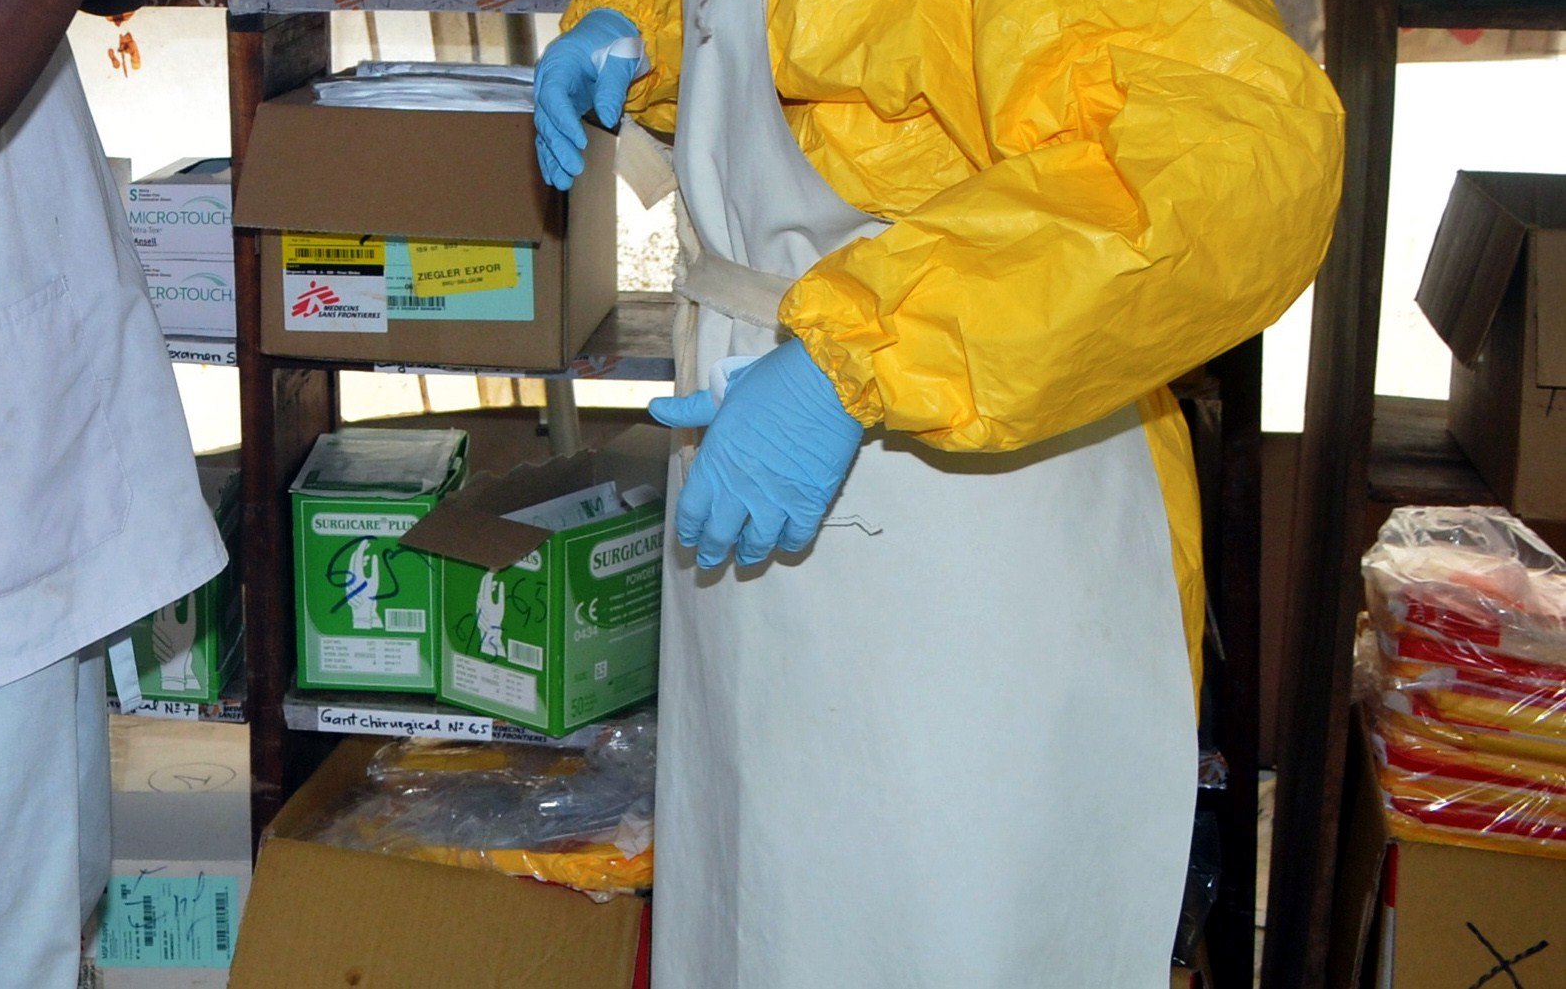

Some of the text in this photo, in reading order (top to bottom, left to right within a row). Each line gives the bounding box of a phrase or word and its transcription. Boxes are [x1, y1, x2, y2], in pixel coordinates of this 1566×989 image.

[129, 188, 138, 202] S
[134, 237, 157, 247] Ansell
[418, 263, 502, 281] ZIEGLER EXPOR
[318, 311, 337, 319] SANS
[183, 704, 195, 716] 7
[320, 708, 357, 725] Gant
[360, 714, 442, 735] chirurgical
